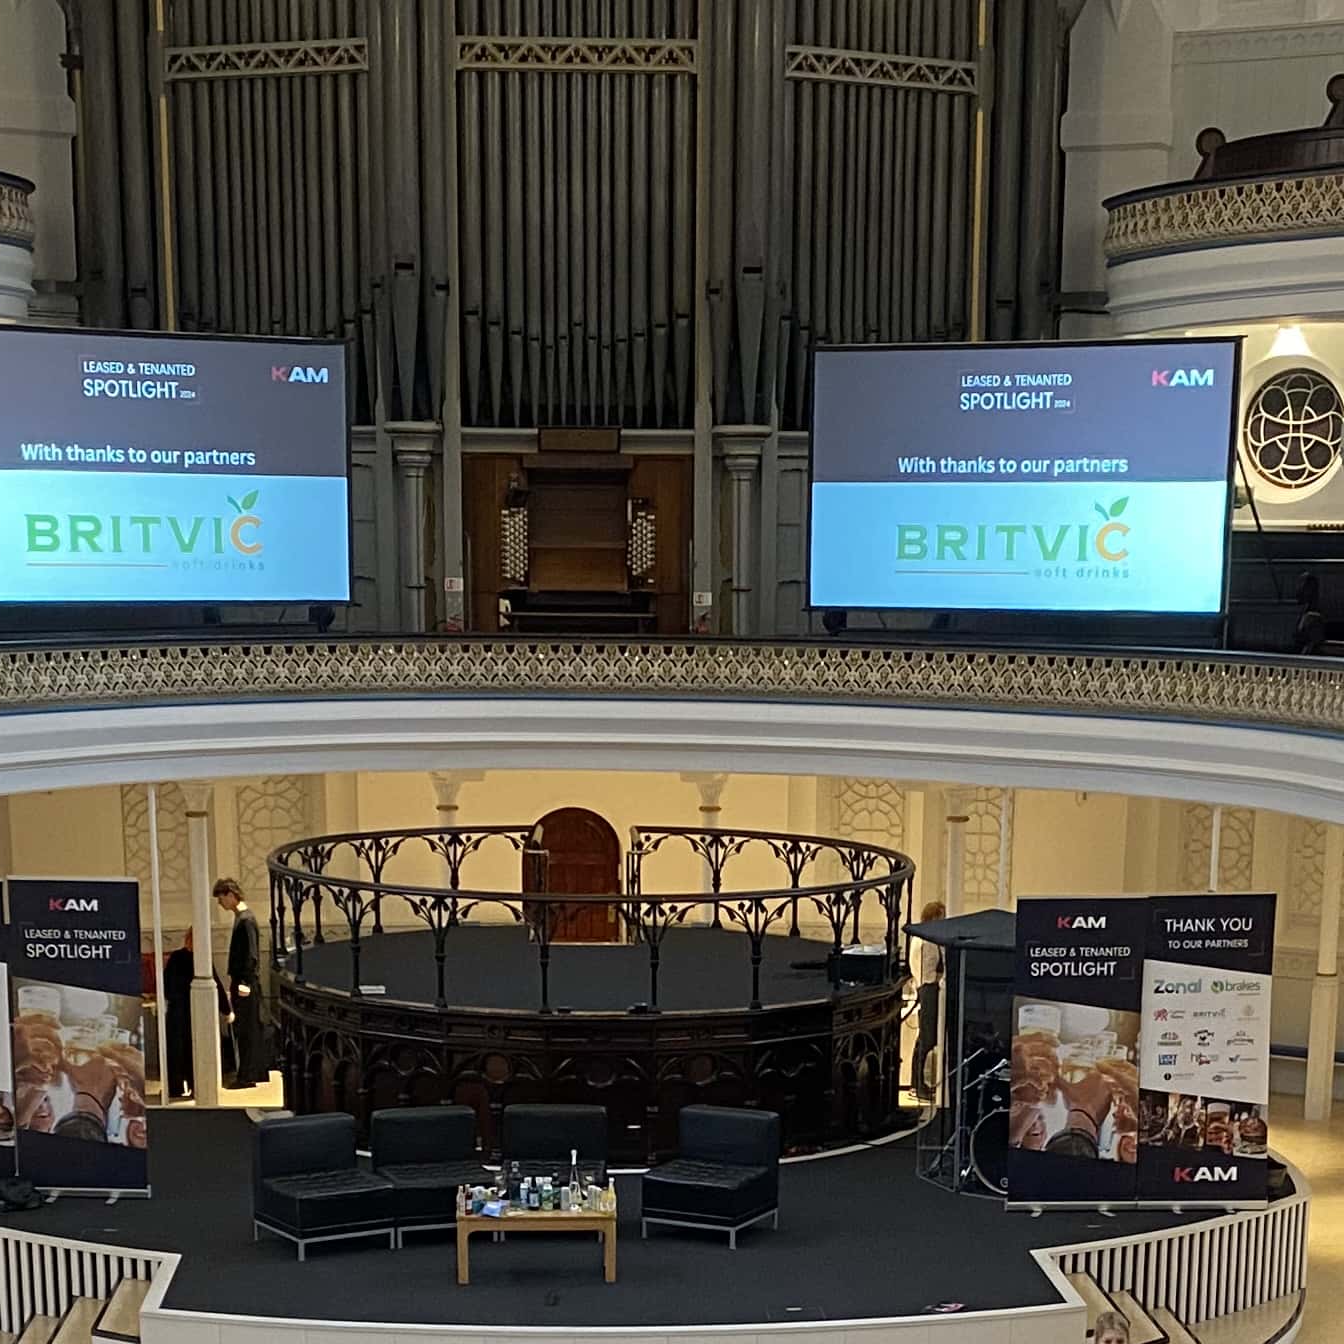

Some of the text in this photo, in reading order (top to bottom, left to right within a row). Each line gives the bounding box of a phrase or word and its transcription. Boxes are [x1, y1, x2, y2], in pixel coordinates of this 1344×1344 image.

[84, 361, 195, 376] LEASED & TENANTED
[271, 367, 329, 383] KAM
[961, 373, 1072, 387] LEASED & TENANTED
[1151, 369, 1214, 386] KAM
[83, 379, 179, 398] SPOTLIGHT
[960, 392, 1053, 409] SPOTLIGHT
[21, 444, 256, 468] With thanks to our partners
[898, 457, 1129, 477] With thanks to our partners
[25, 514, 263, 554] BRITVIC
[896, 522, 1131, 561] BRITVIC
[1076, 567, 1130, 579] drinks
[49, 898, 99, 912] KAM
[1057, 916, 1106, 929] KAM
[1165, 917, 1253, 933] THANK YOU
[24, 929, 126, 941] LEASED & TENANTED
[1030, 946, 1131, 957] LEASED & TENANTED
[1168, 938, 1249, 949] TO OUR PARTNERS
[26, 944, 113, 960] SPOTLIGHT
[1030, 961, 1117, 977] SPOTLIGHT
[1153, 978, 1202, 994] Zonal
[1225, 981, 1261, 992] brakes
[1174, 1166, 1238, 1182] KAM
